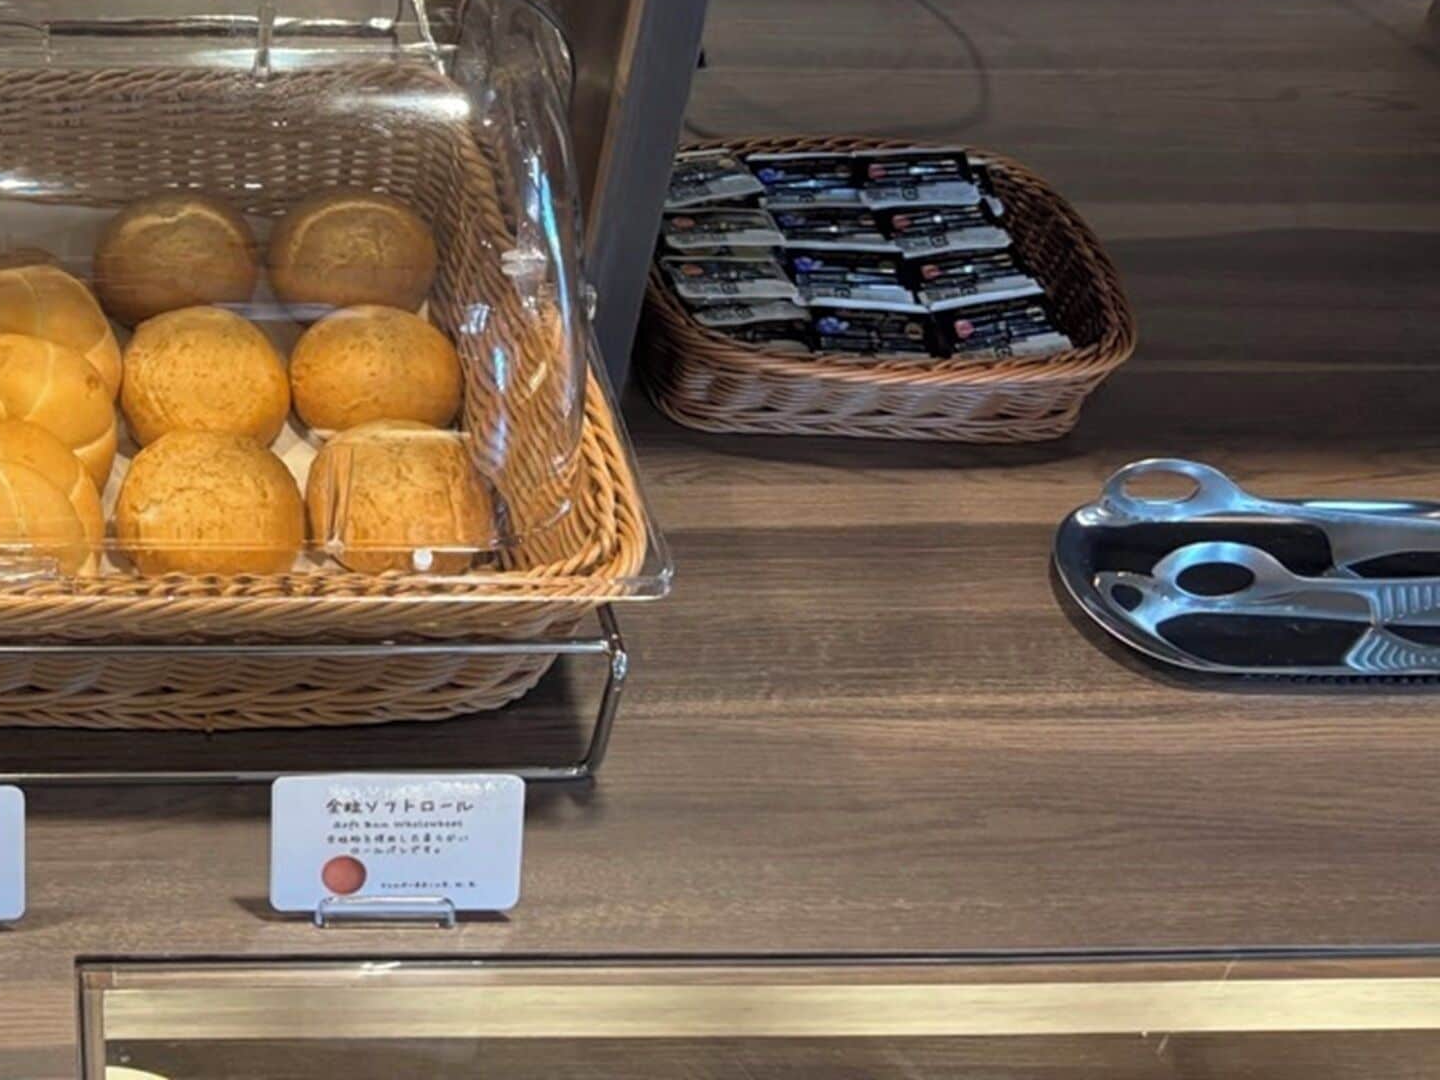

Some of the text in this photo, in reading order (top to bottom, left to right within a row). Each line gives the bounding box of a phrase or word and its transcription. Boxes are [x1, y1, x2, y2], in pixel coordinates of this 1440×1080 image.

[326, 798, 474, 814] 全粒ソフトロール
